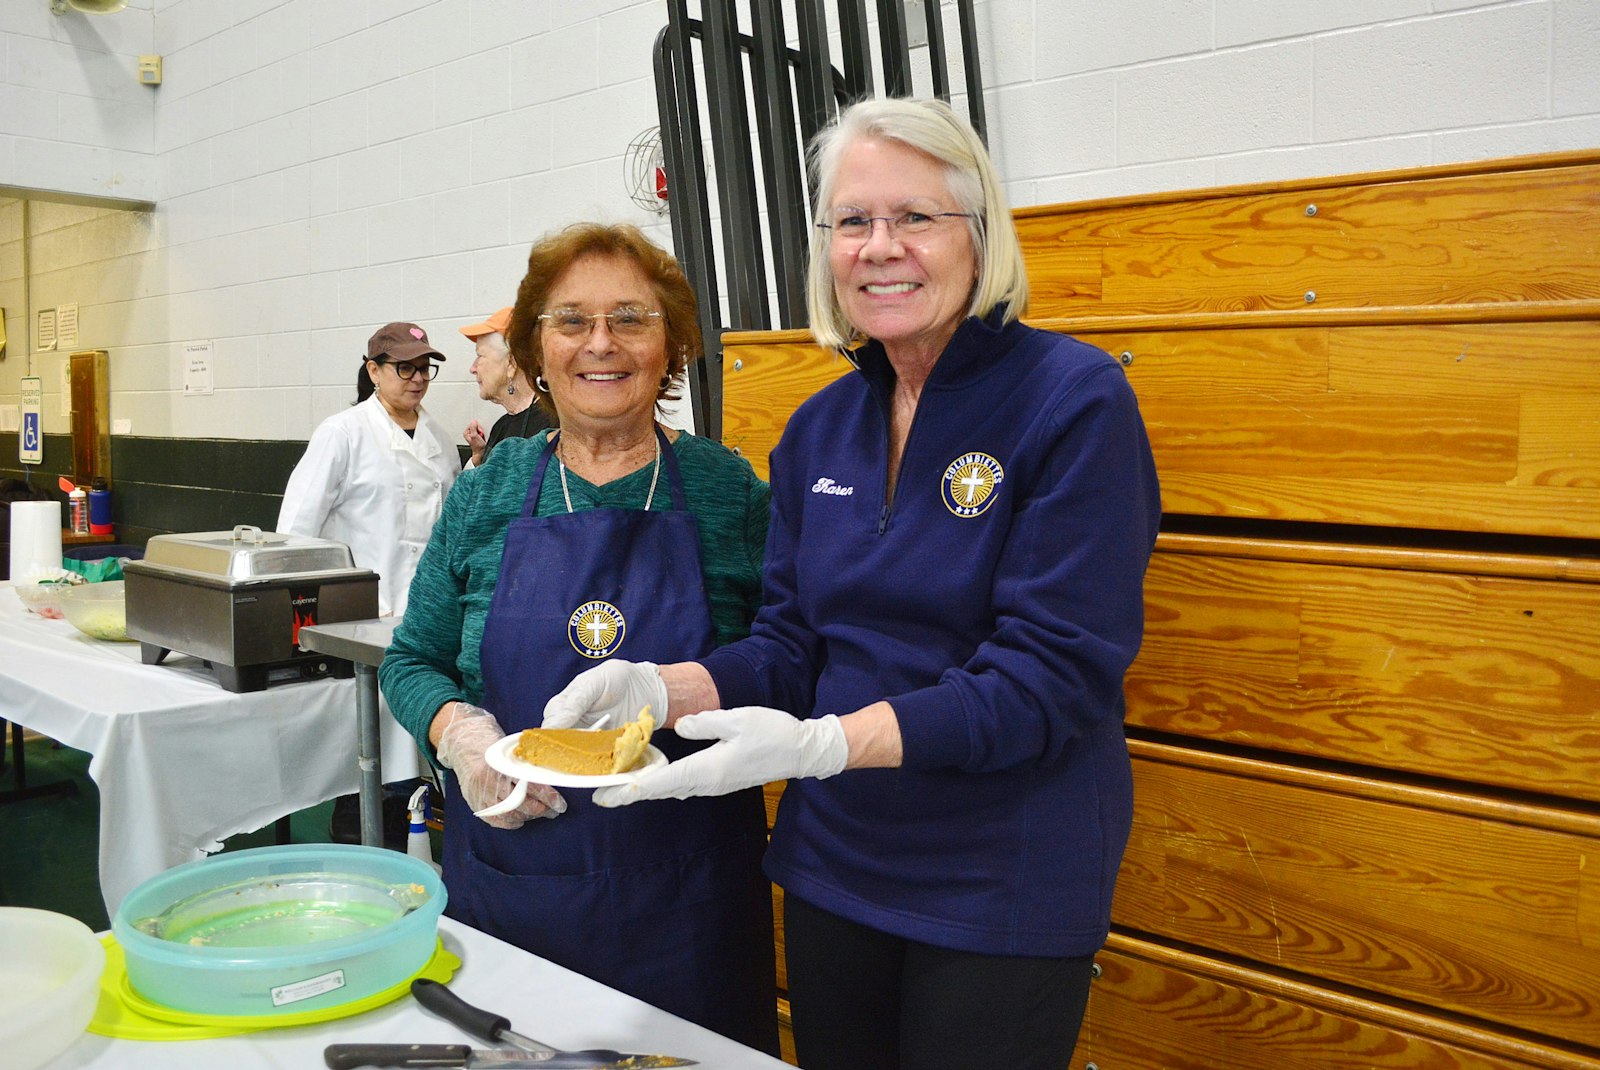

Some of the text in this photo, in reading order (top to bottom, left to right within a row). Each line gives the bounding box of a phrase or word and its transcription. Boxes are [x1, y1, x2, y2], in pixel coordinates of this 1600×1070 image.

[945, 453, 1002, 485] COLUMBIETTES
[811, 477, 854, 497] Karen
[292, 597, 317, 607] cayenne
[570, 603, 623, 627] COLUMBIETTES
